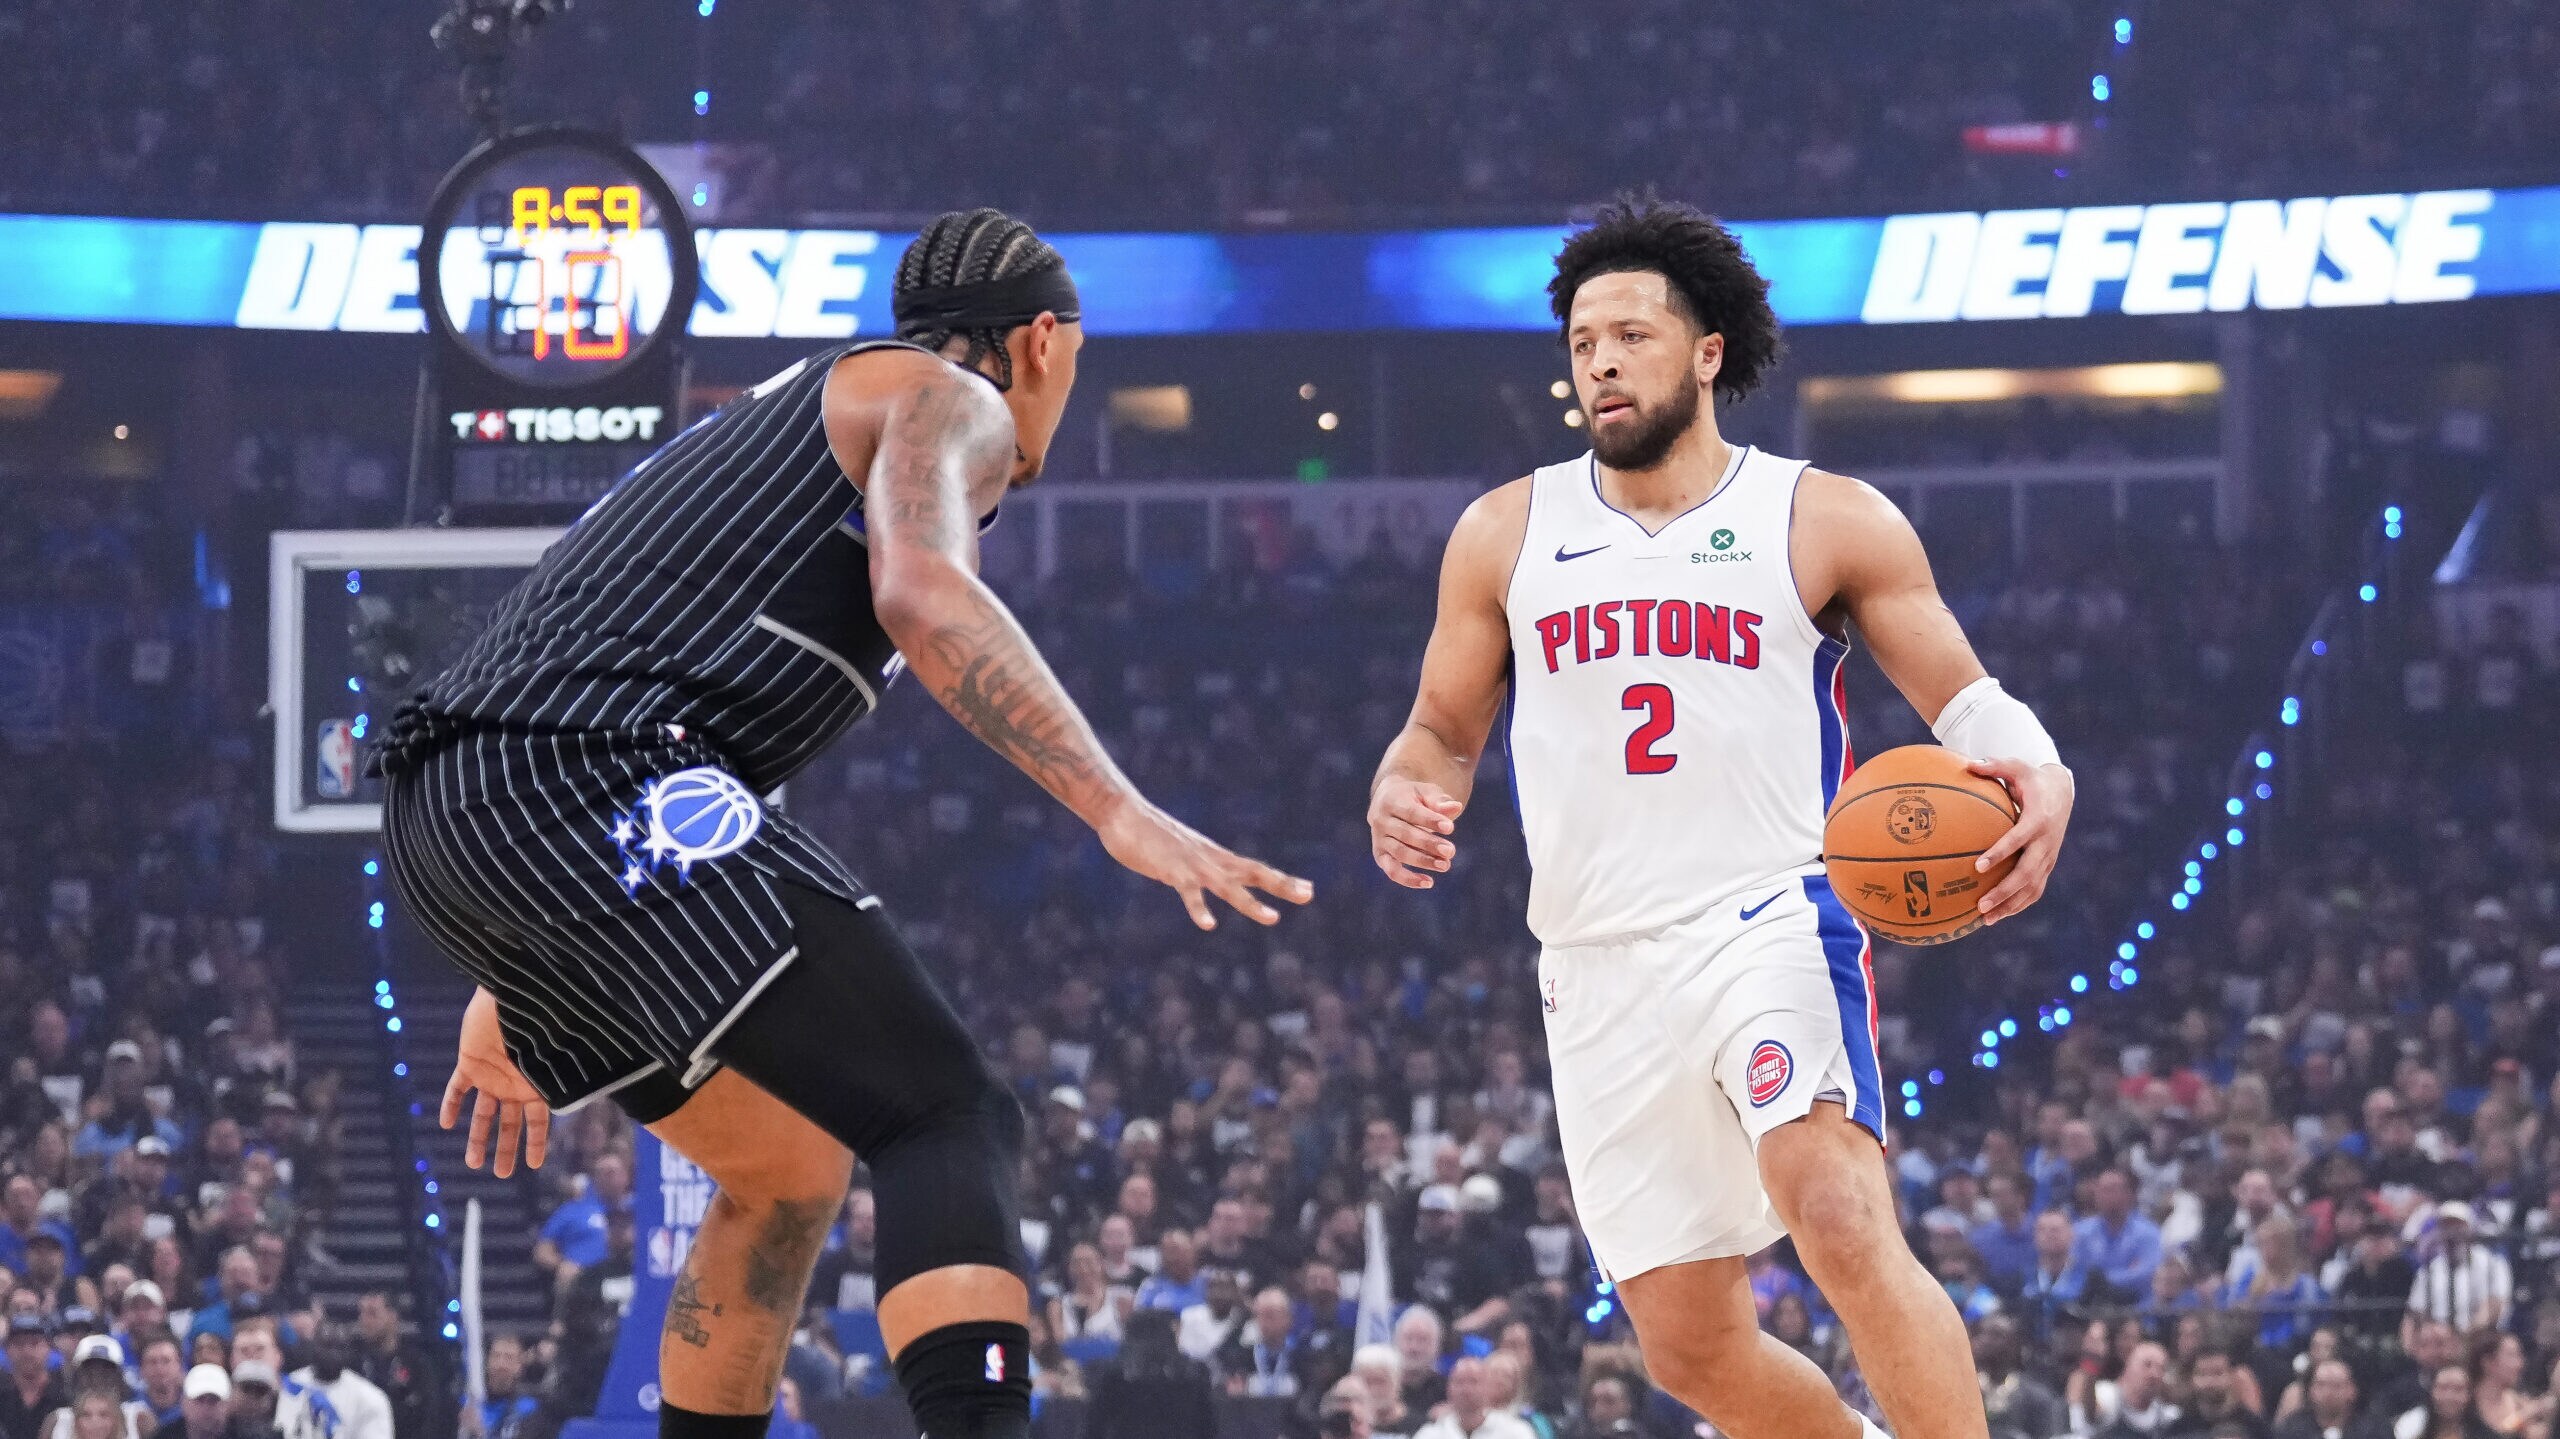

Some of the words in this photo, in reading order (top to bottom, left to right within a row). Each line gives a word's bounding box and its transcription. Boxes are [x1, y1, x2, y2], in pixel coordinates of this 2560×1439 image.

[512, 185, 642, 246] 8:59
[1860, 189, 2494, 324] DEFENSE
[507, 406, 663, 442] TISSOT
[1691, 551, 1752, 564] StockX
[1535, 599, 1763, 674] PISTONS
[1621, 683, 1678, 775] 2
[1751, 1057, 1780, 1080] DETROIT
[1751, 1068, 1782, 1091] PISTONS
